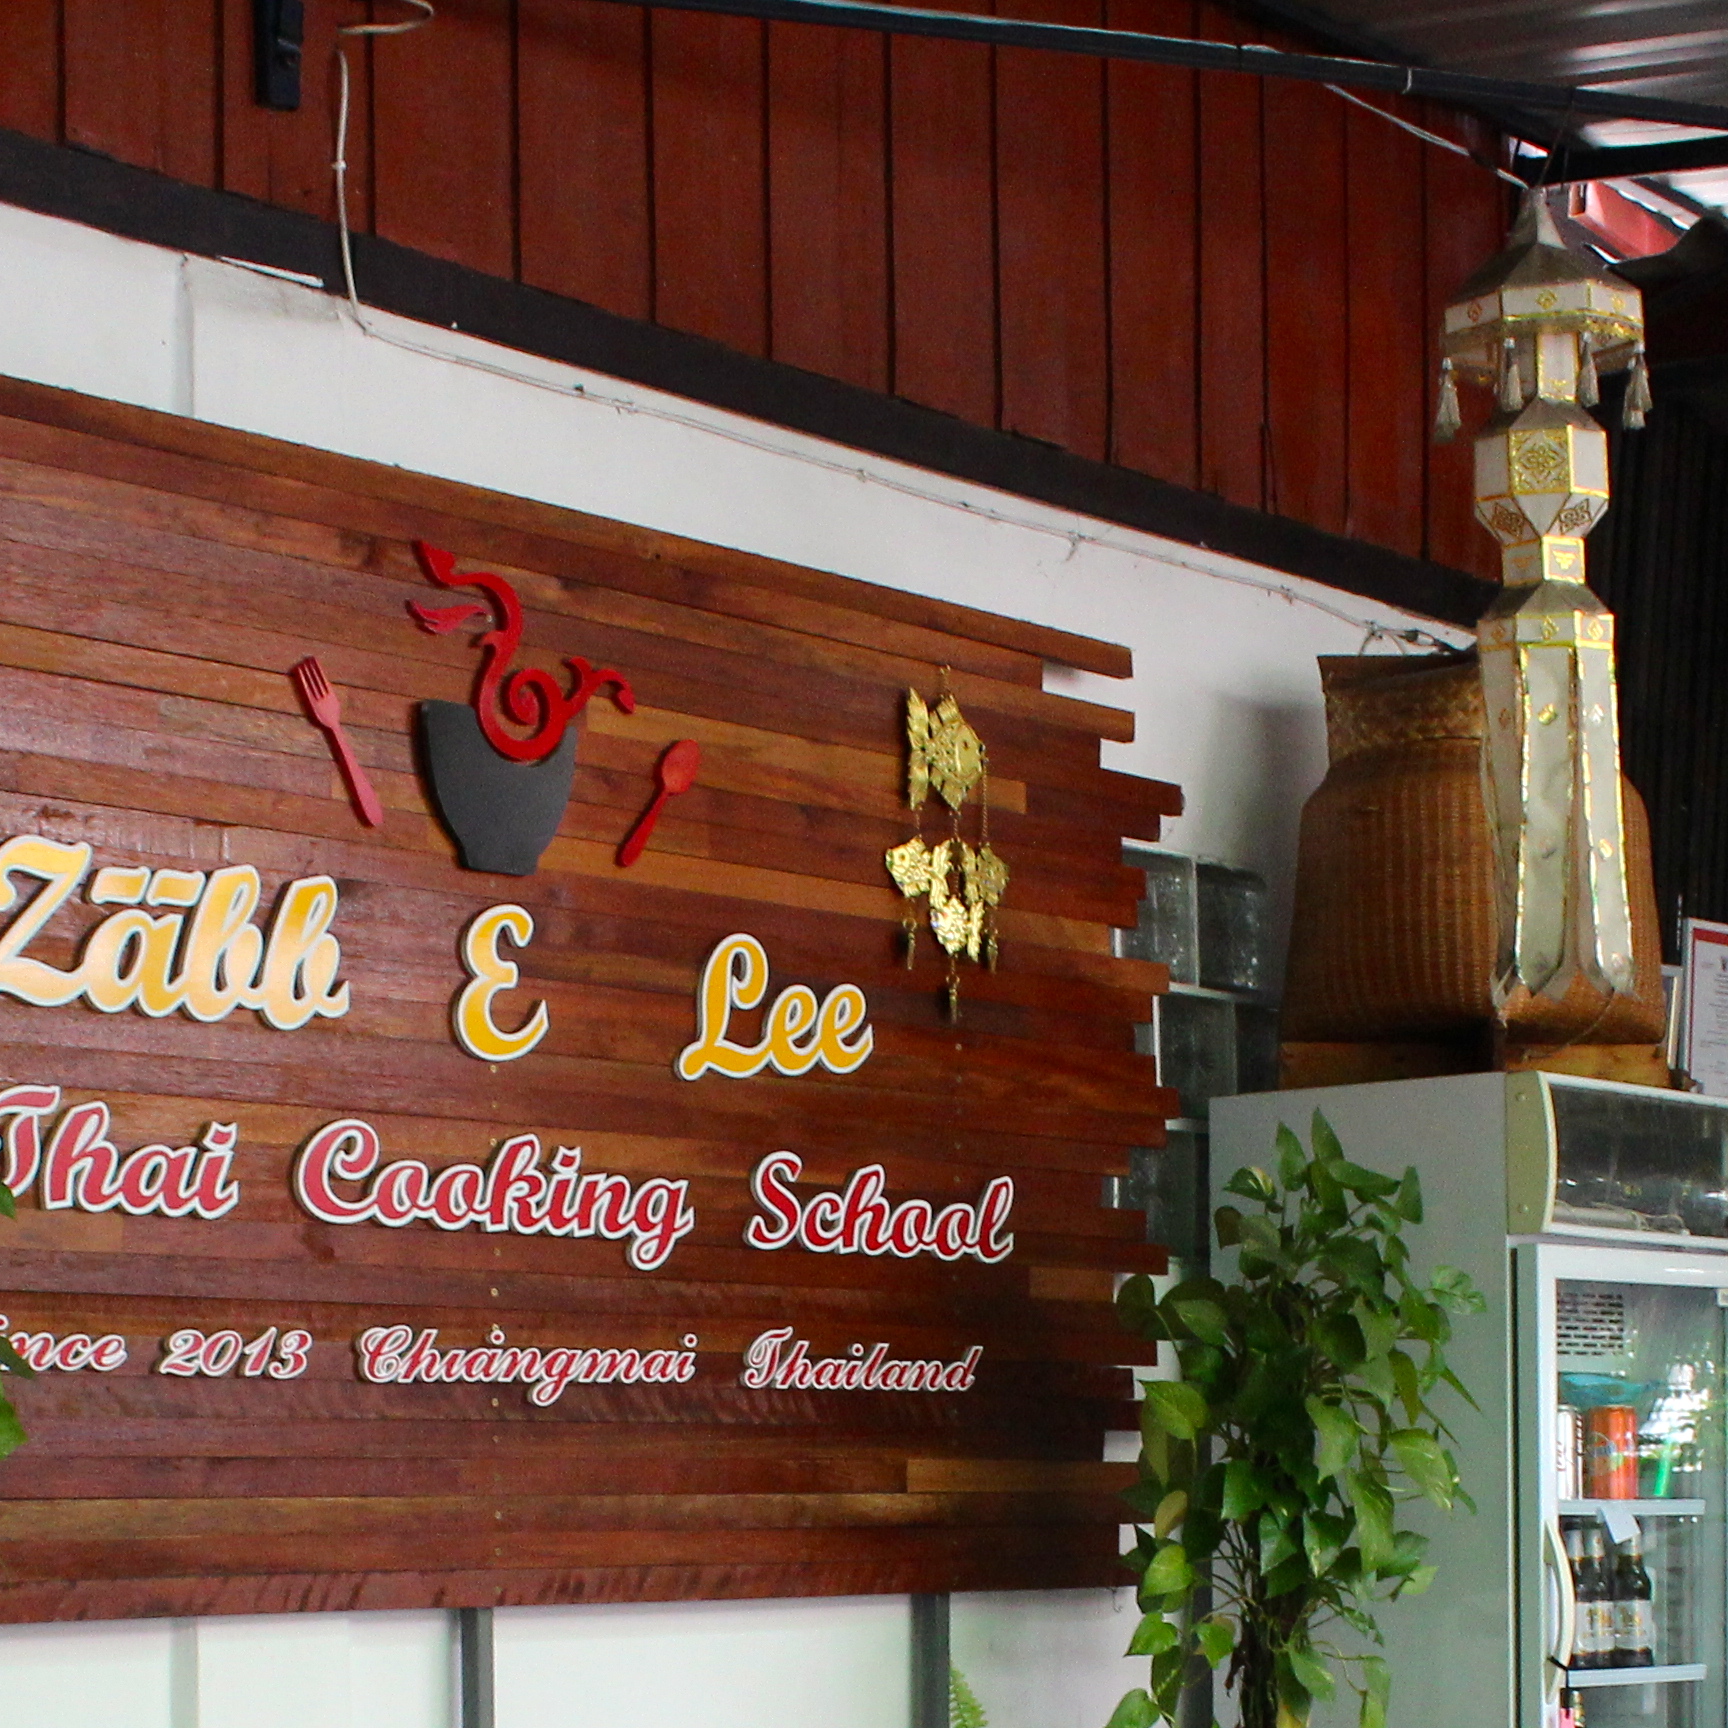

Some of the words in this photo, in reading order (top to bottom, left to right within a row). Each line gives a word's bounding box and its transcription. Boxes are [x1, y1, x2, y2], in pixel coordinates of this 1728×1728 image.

[457, 903, 549, 1062] E
[677, 932, 873, 1081] Lee
[295, 1118, 695, 1271] Cooking
[746, 1149, 1015, 1264] School
[158, 1326, 309, 1378] 2013
[355, 1322, 697, 1407] Chiangmai
[740, 1328, 984, 1391] Thailand
